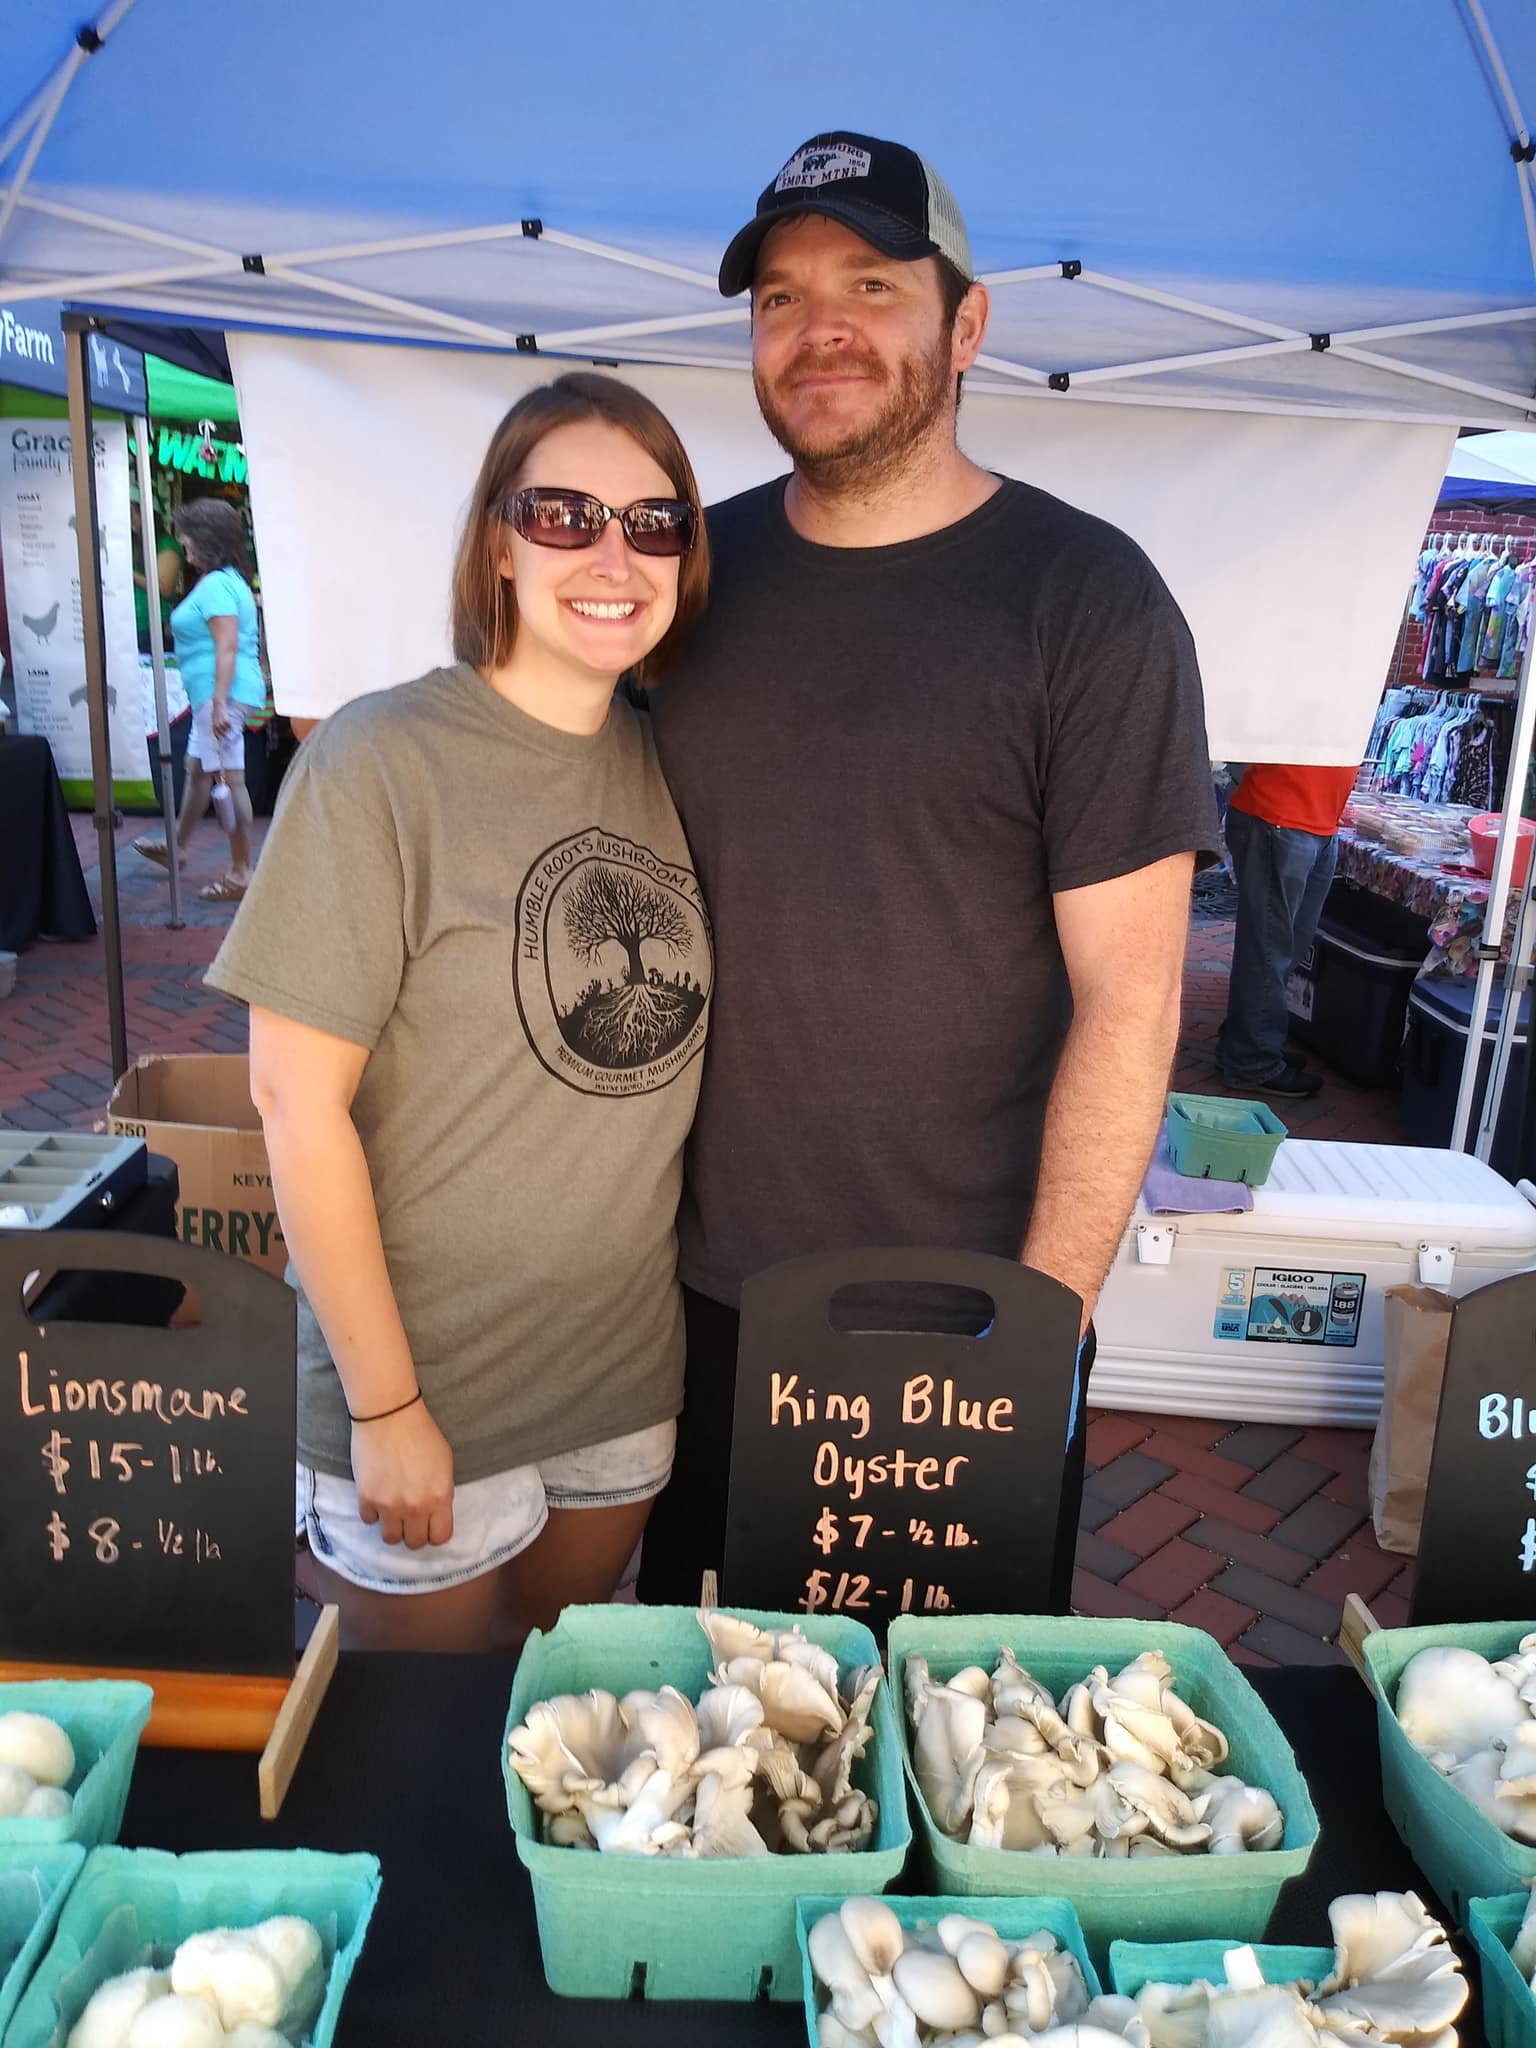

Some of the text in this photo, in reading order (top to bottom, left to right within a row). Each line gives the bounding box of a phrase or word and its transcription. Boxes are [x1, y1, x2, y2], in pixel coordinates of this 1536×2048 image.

[781, 167, 857, 188] SMOKY MTNS
[12, 428, 106, 453] Gracs
[523, 876, 549, 960] HUMBLE
[543, 838, 594, 880] ROOTS
[595, 1069, 645, 1083] GOURMET
[647, 1022, 705, 1079] MUSHROOMS
[114, 1121, 147, 1137] 250
[1271, 1273, 1315, 1284] IGLOO
[18, 1350, 249, 1425] Lionsmane
[769, 1372, 1015, 1440] King Blue
[812, 1441, 970, 1500] Oyster
